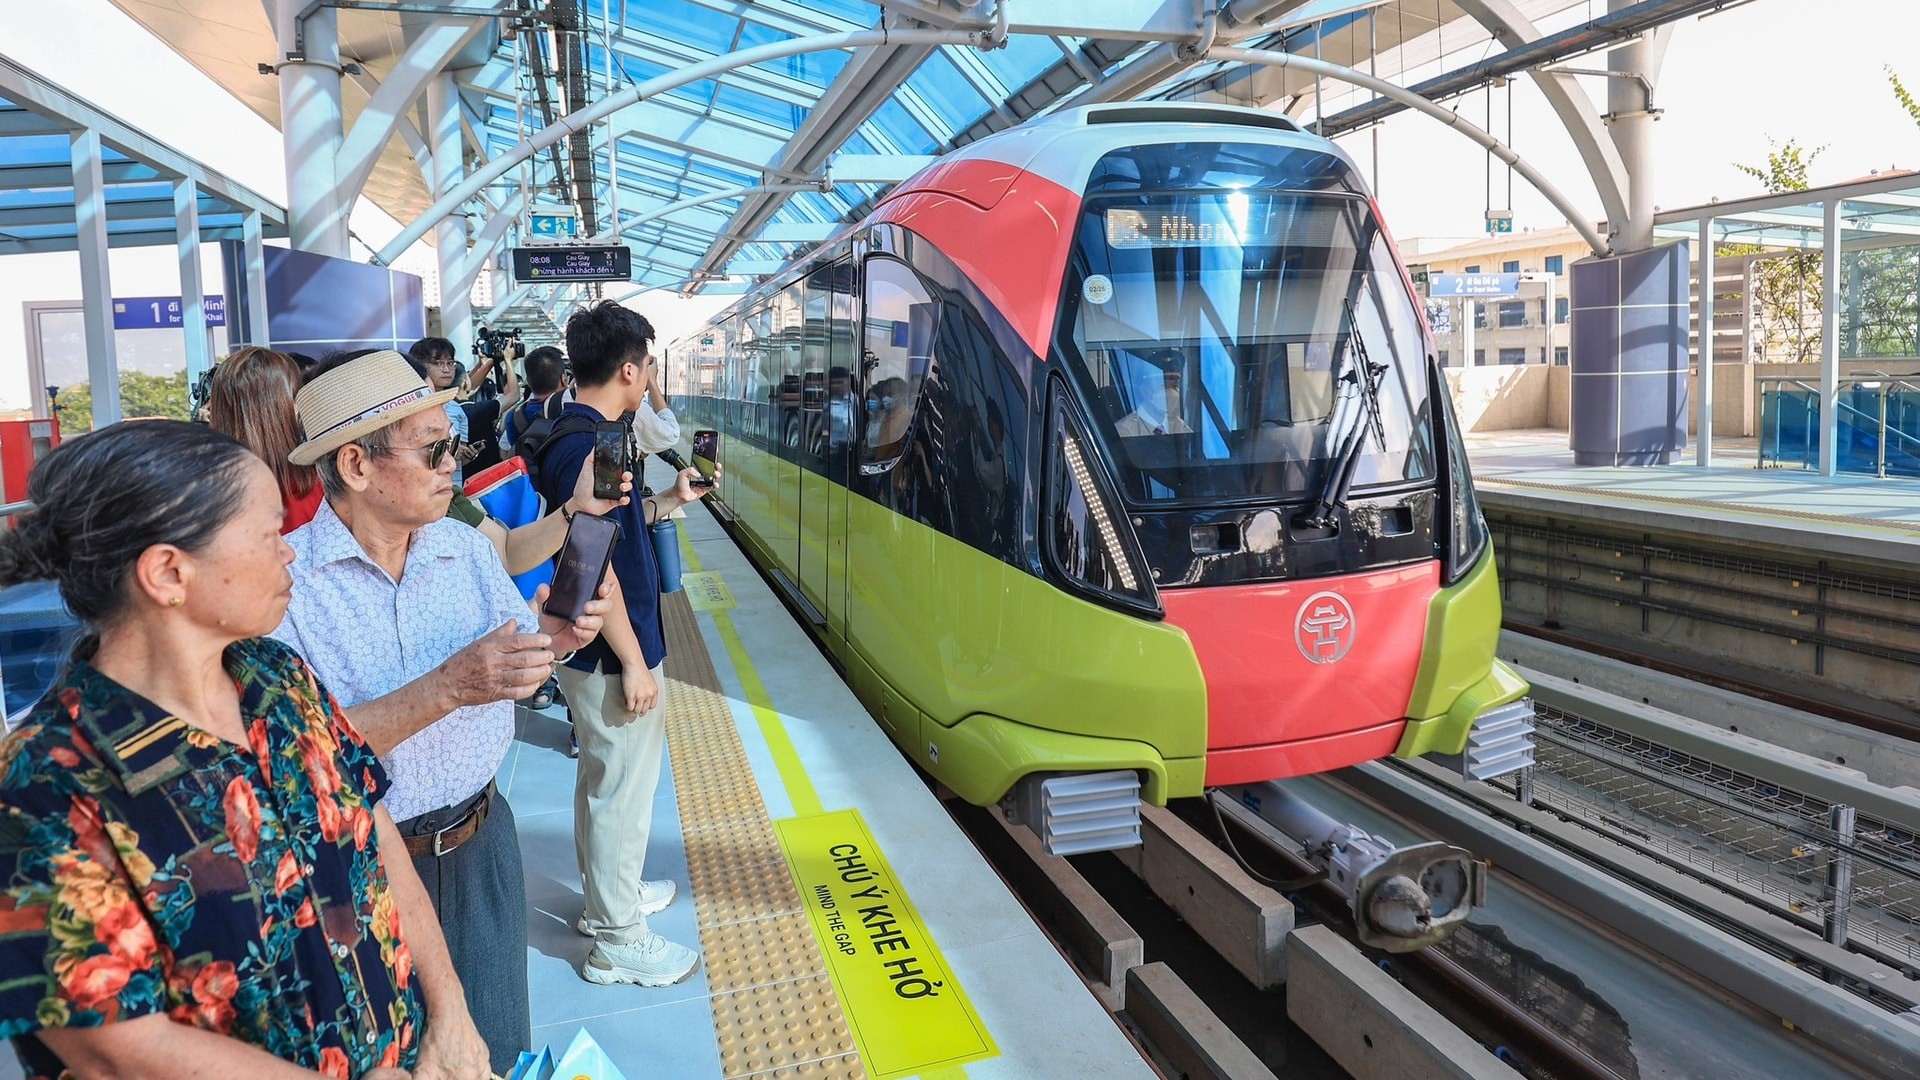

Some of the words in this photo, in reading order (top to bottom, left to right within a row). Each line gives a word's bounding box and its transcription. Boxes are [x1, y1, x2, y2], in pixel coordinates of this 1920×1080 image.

[529, 256, 551, 264] 08:08
[1455, 276, 1464, 293] 2
[150, 302, 161, 323] 1
[168, 302, 178, 312] đi
[169, 315, 182, 323] for
[829, 844, 880, 884] CHÚ
[814, 884, 836, 910] MIND
[850, 885, 890, 899] Ý
[826, 911, 846, 932] THE
[857, 904, 911, 955] KHE
[834, 933, 856, 956] GAP
[883, 957, 943, 999] HỞ
